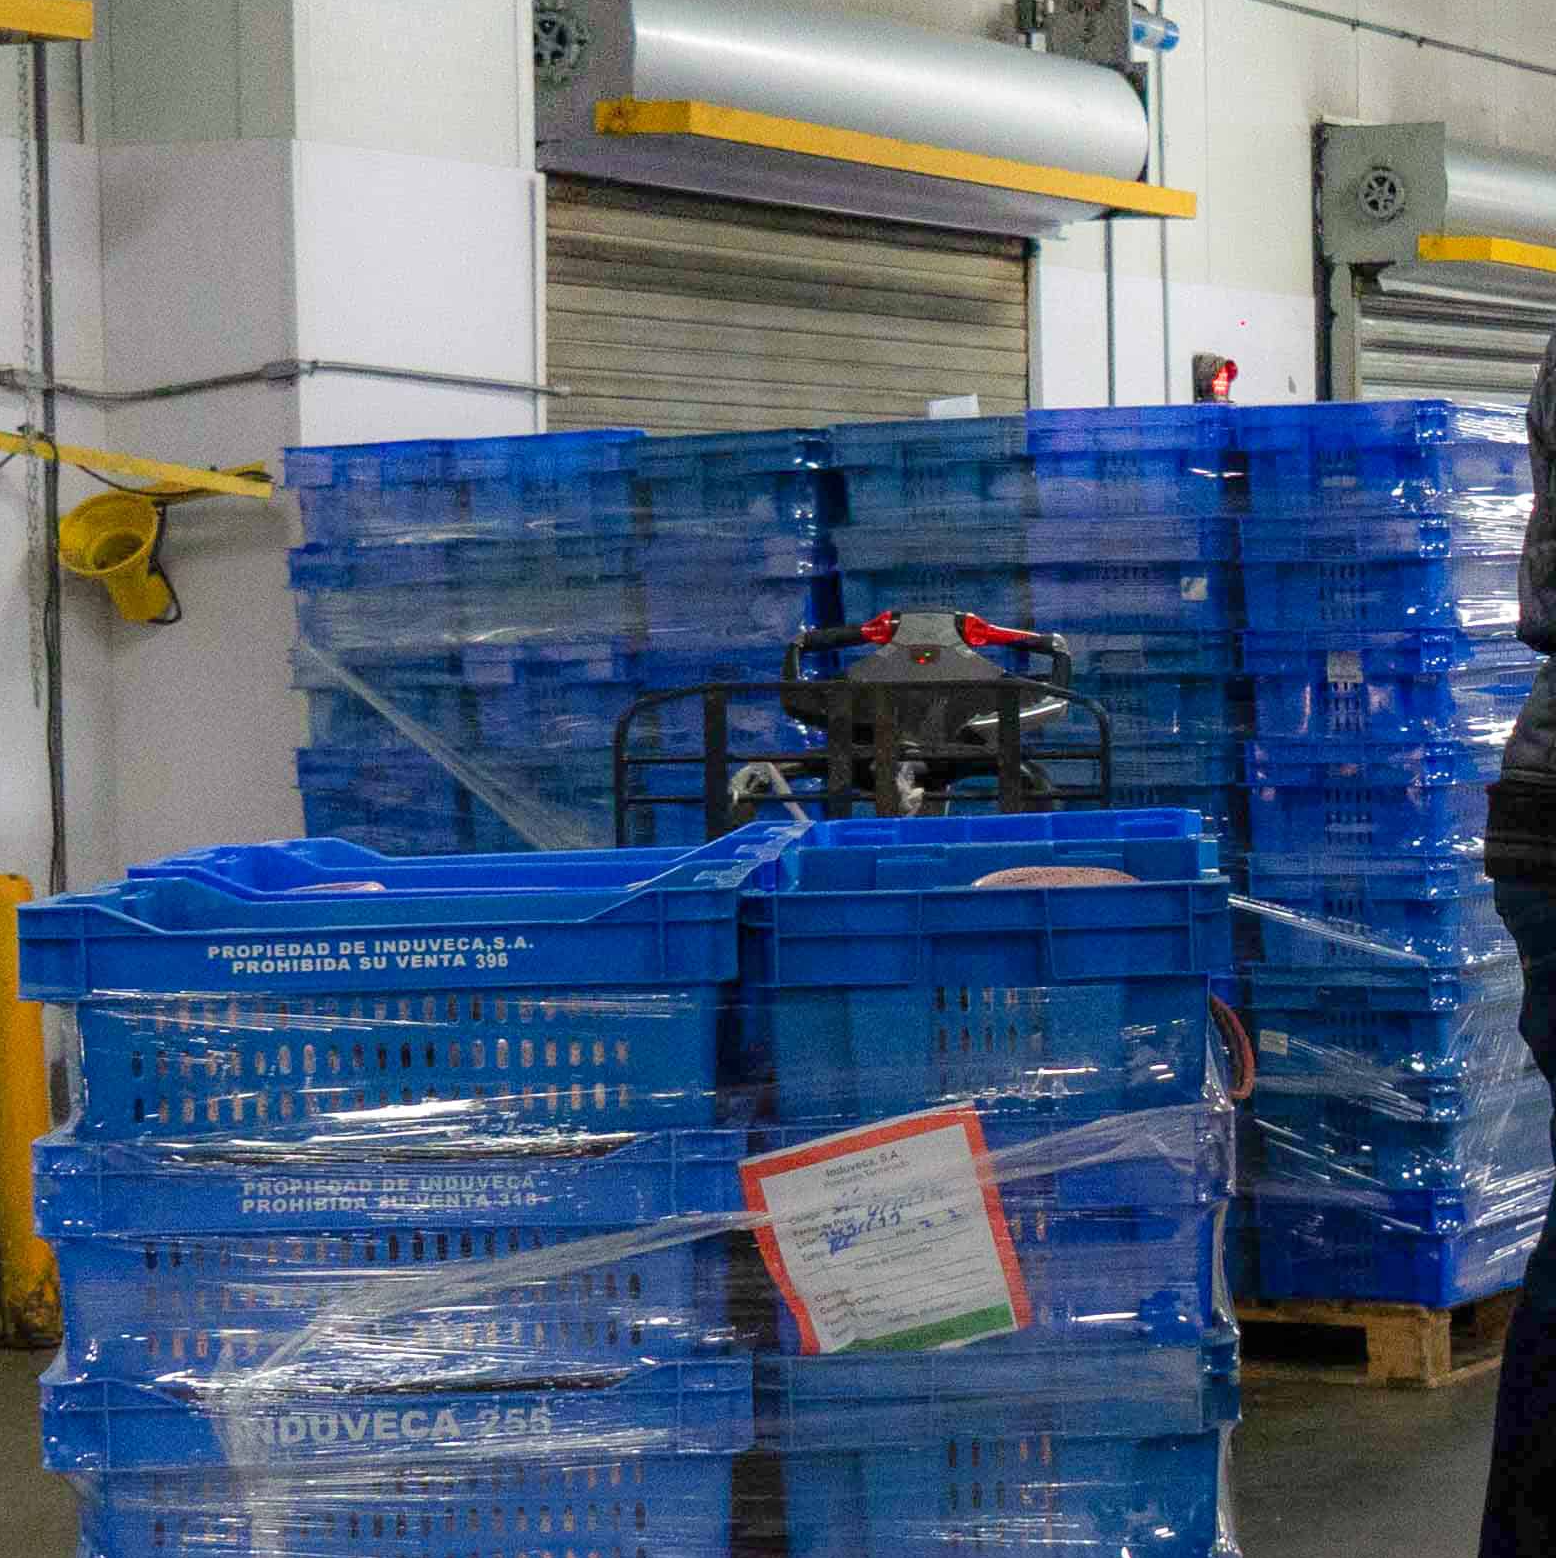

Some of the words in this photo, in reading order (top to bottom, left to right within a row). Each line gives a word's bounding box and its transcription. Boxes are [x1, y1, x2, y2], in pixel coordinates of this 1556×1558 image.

[207, 942, 329, 959] PROPIEDAD
[340, 940, 366, 956] DE
[374, 936, 535, 955] INDUVECA,S.A.
[232, 955, 352, 974] PROHIBIDA
[359, 954, 388, 970] SU
[395, 953, 467, 969] VENTA
[474, 953, 509, 970] 396
[243, 1177, 374, 1196] PROPIEDAD
[382, 1177, 410, 1193] DE
[419, 1174, 536, 1193] INDUVECA
[241, 1195, 369, 1214] PROHIBIDA
[378, 1194, 406, 1210] SU
[414, 1192, 490, 1210] VENTA
[498, 1191, 538, 1208] 318
